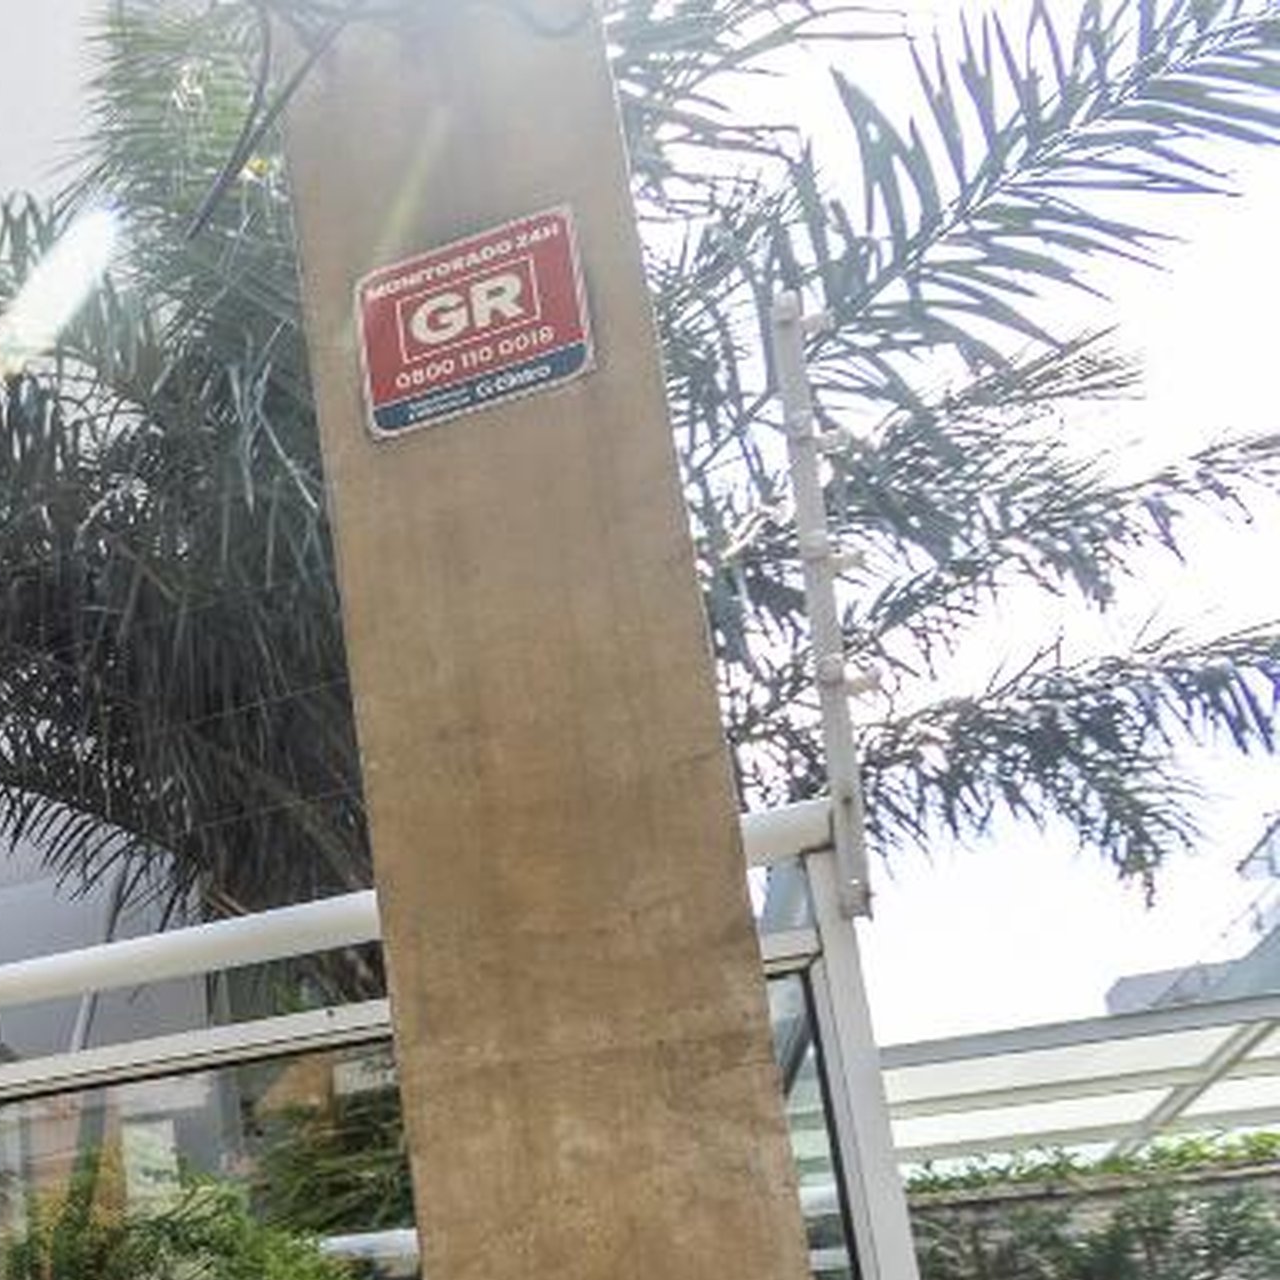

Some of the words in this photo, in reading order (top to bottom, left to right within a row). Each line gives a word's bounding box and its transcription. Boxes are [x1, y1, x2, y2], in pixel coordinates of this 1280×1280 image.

[366, 240, 512, 299] MONITORADO
[409, 274, 524, 345] GR
[395, 358, 454, 389] 0800
[461, 346, 492, 369] 110
